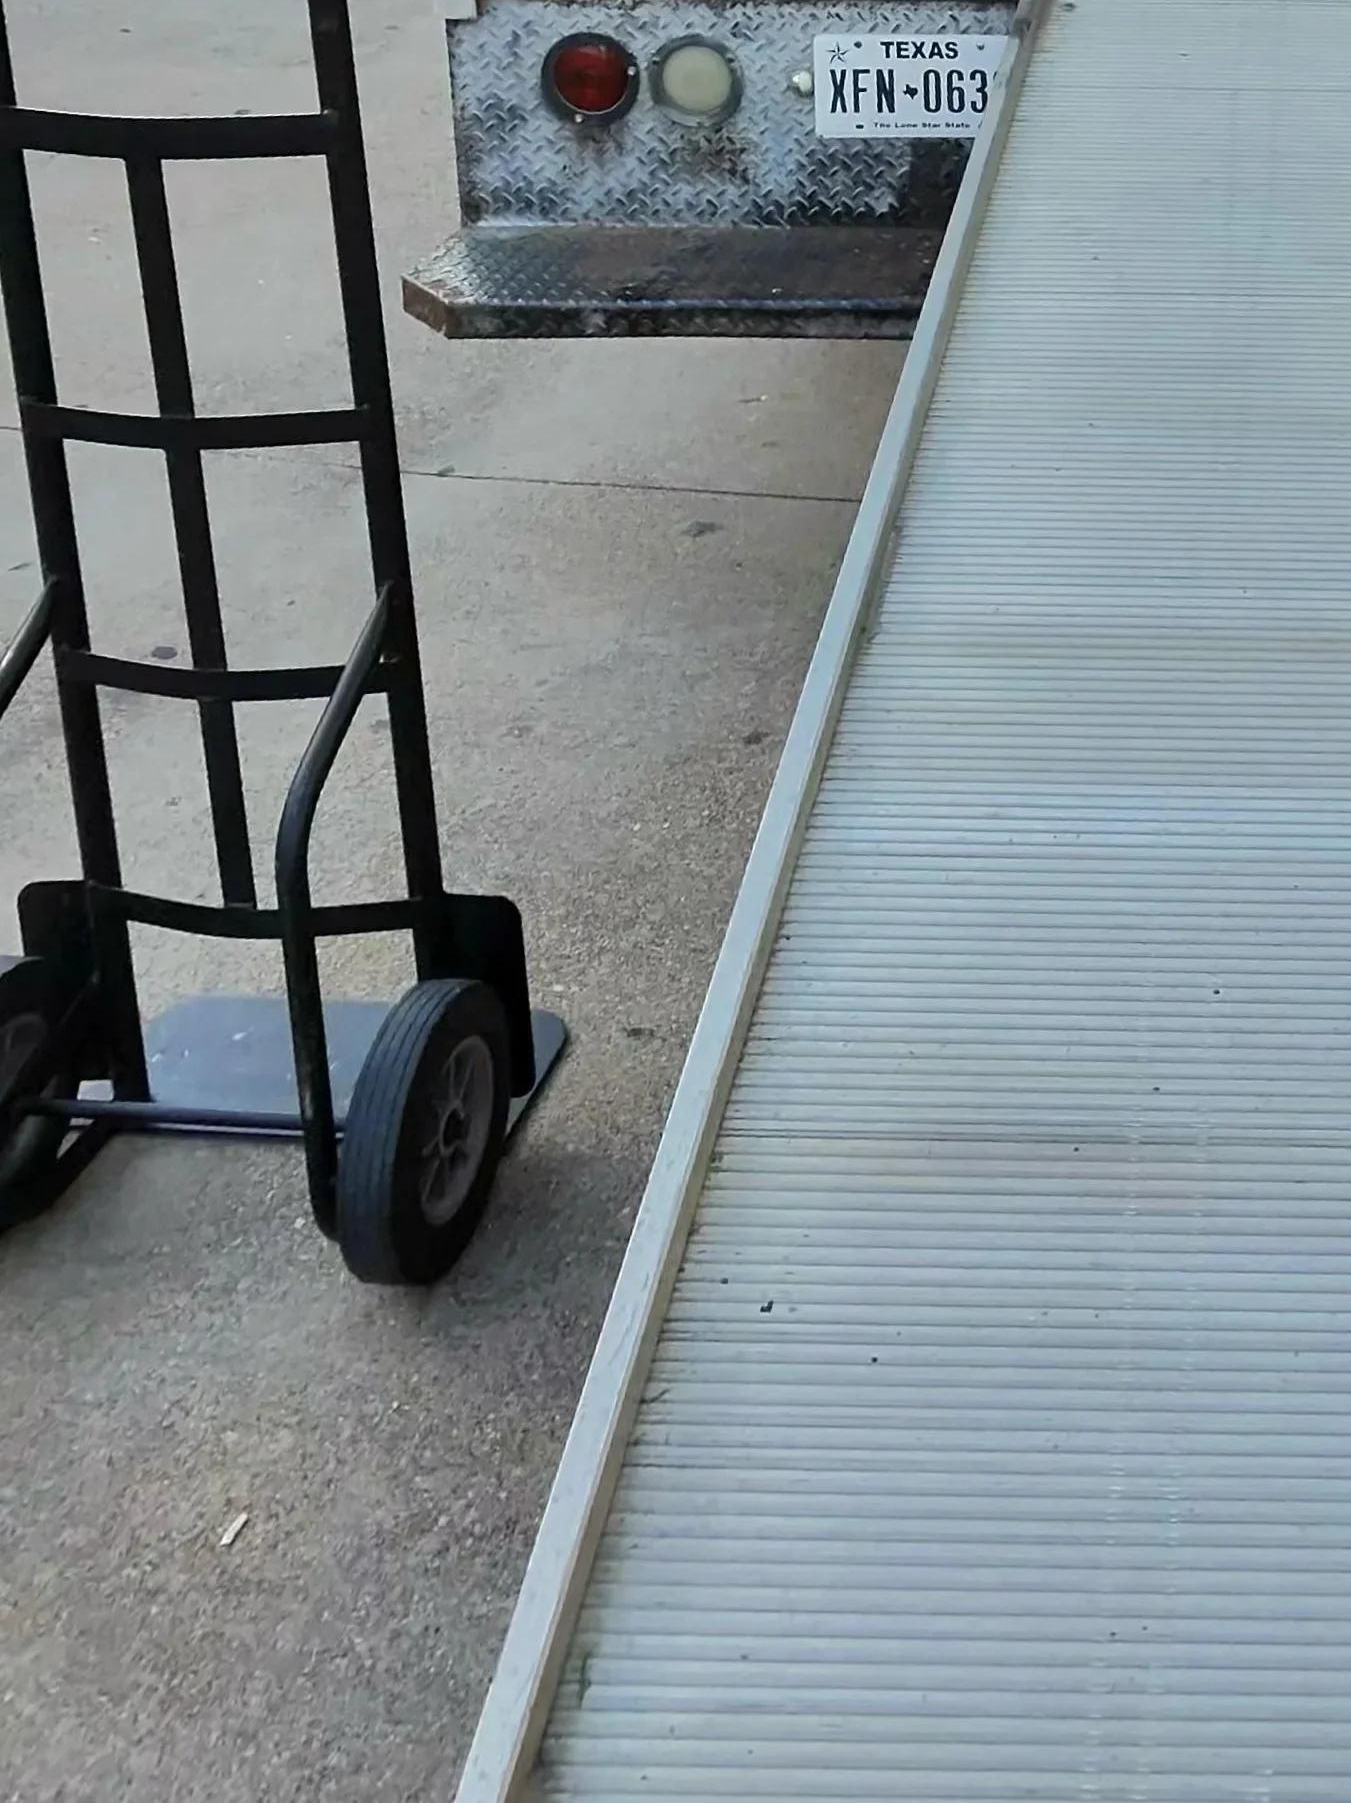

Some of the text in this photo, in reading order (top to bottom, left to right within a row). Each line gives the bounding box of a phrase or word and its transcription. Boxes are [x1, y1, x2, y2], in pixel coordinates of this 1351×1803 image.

[880, 41, 959, 59] TEXAS
[829, 68, 998, 114] XFN 063
